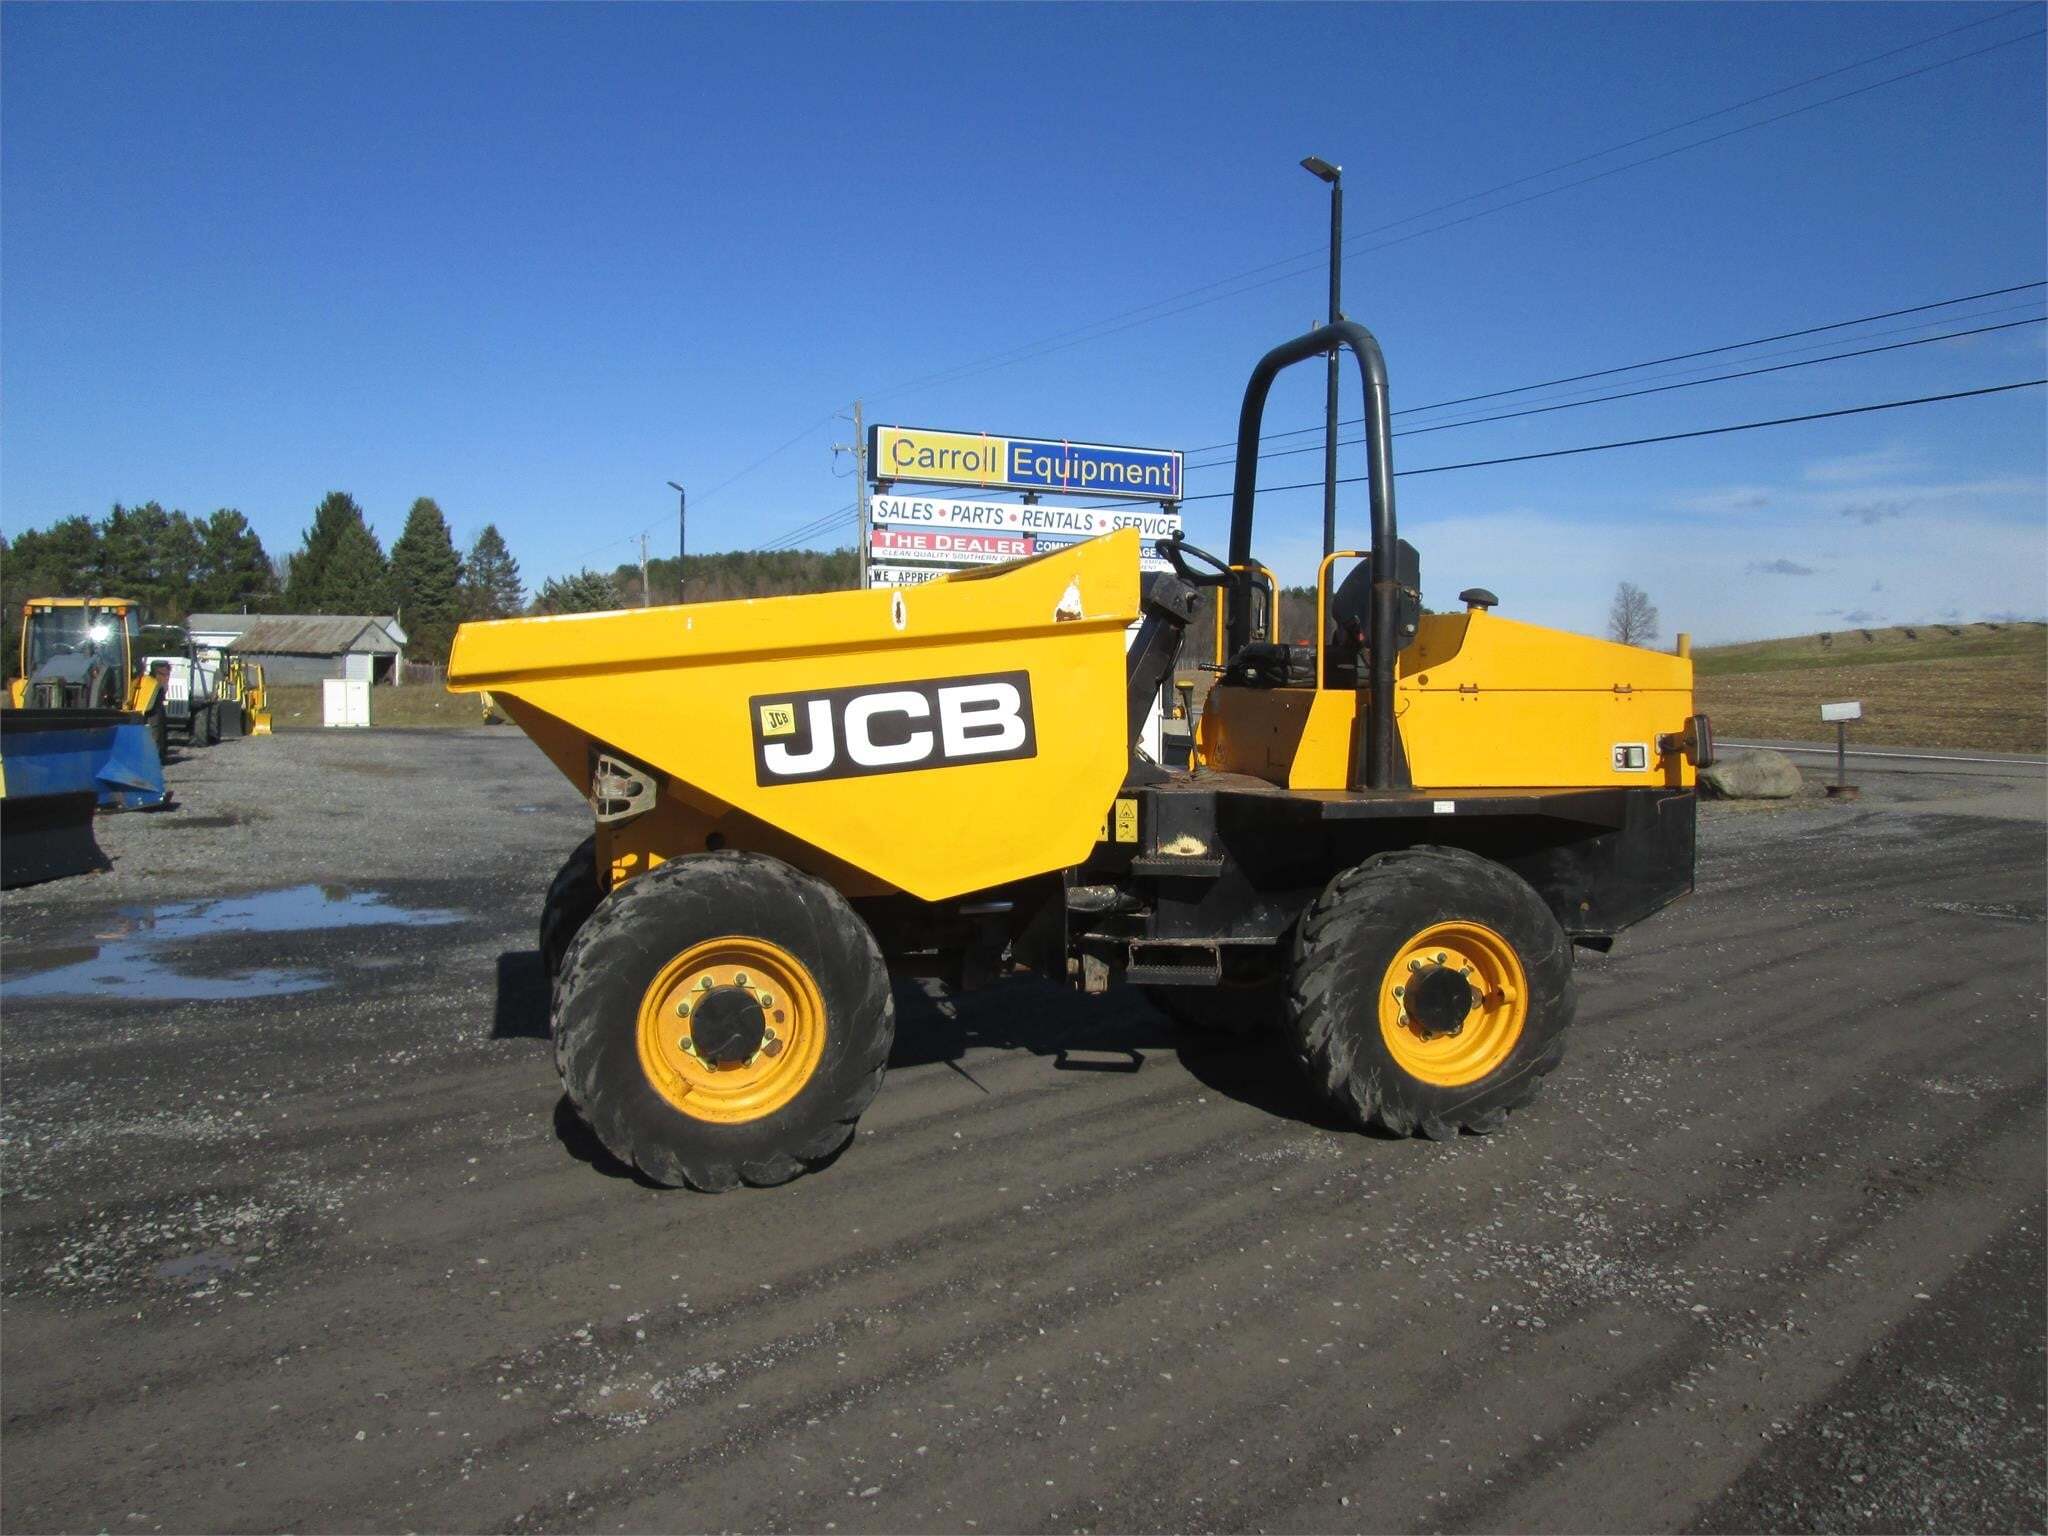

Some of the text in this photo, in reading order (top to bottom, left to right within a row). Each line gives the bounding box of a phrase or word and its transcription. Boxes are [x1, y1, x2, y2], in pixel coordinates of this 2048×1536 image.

[892, 438, 1170, 486] Carroll Equipment
[878, 500, 1177, 536] SALES PARTS RENTALS SERVICE
[880, 532, 1026, 554] THE DEALER
[882, 549, 912, 557] CLEAN
[913, 551, 949, 559] QUALITY
[952, 553, 998, 561] SOUTHERN
[873, 570, 889, 581] WE
[763, 682, 1027, 775] JCB
[769, 711, 789, 729] JCB
